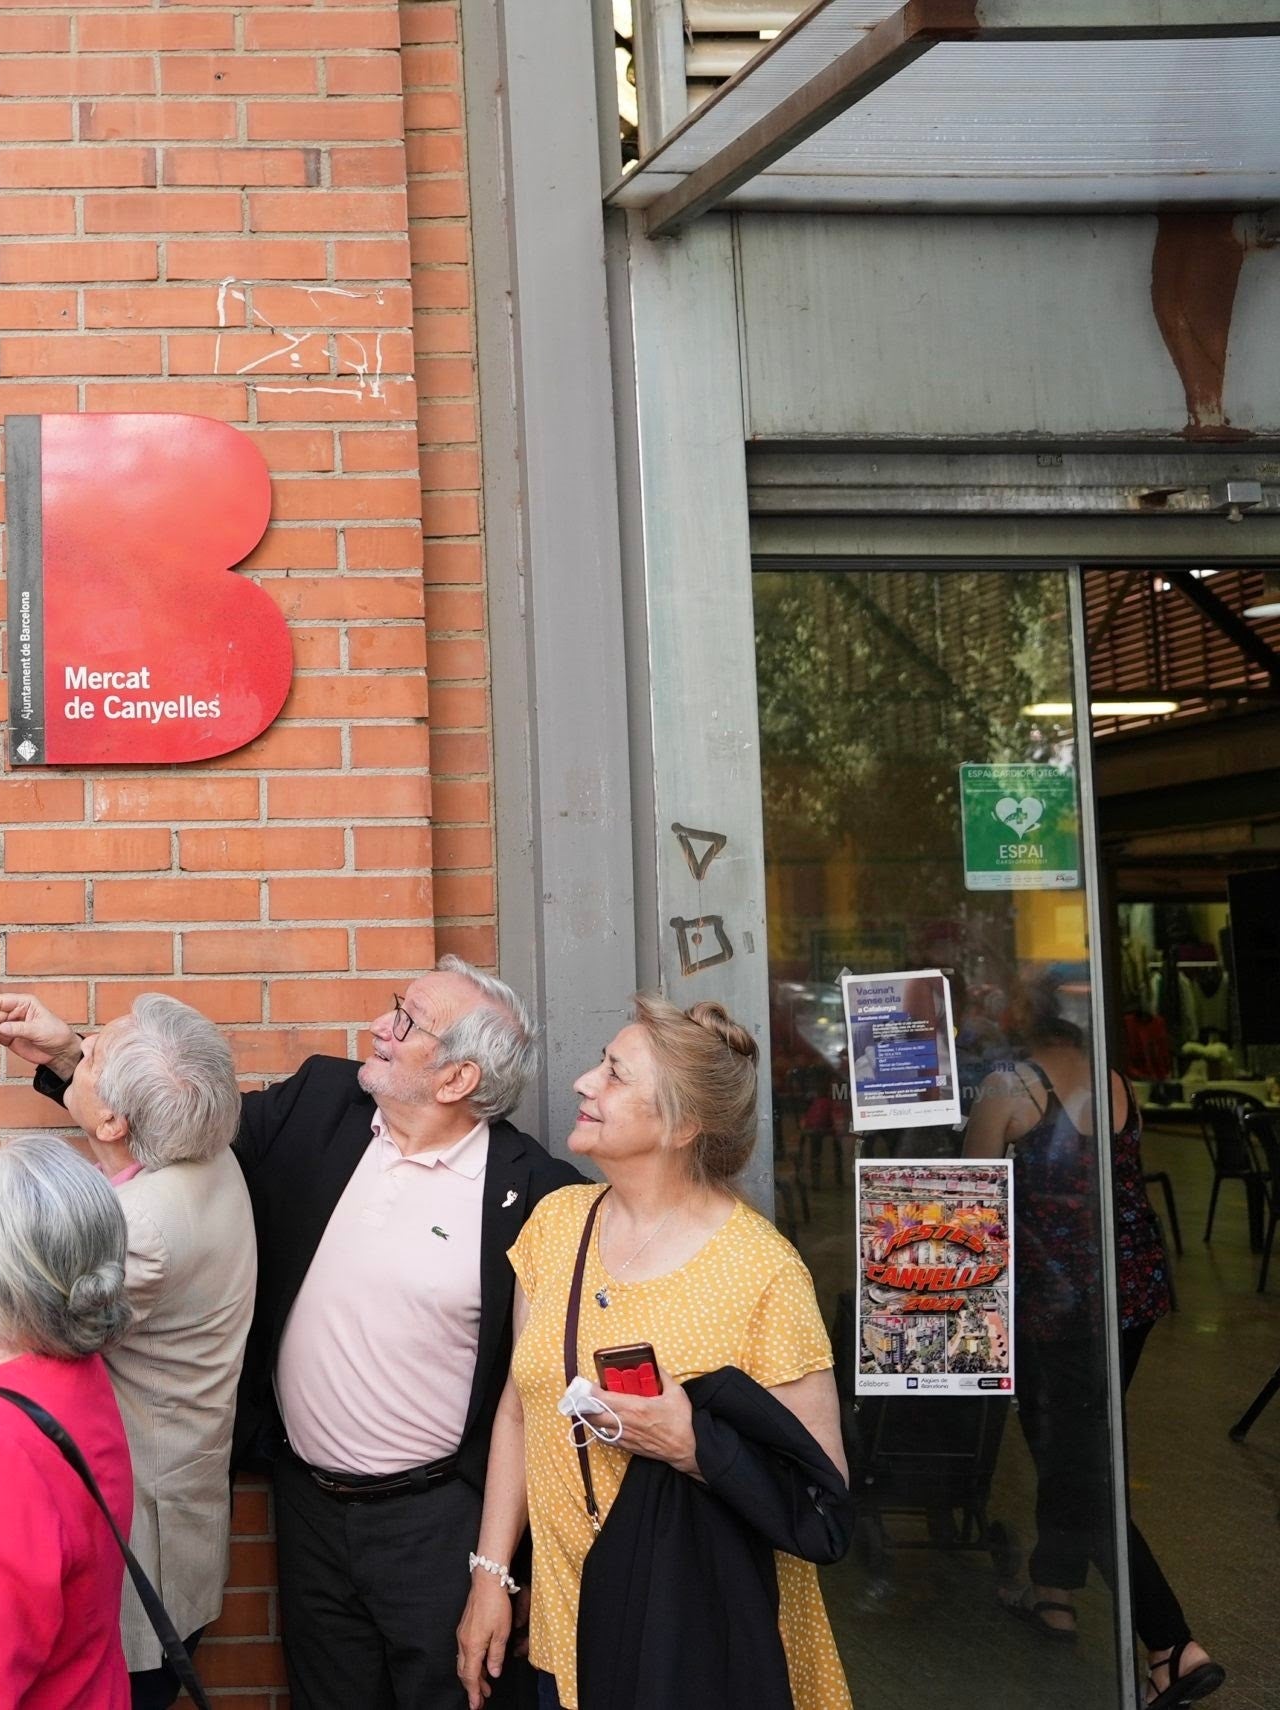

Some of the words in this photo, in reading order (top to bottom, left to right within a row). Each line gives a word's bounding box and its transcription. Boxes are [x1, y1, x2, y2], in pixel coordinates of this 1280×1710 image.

[20, 591, 30, 642] Barcelona
[21, 643, 31, 656] de
[21, 656, 33, 720] Ajuntament
[65, 667, 150, 690] Mercat
[64, 696, 94, 719] de
[104, 695, 221, 724] Canyelles
[999, 844, 1044, 859] ESPAI
[856, 986, 895, 996] Vacuna't
[857, 997, 883, 1005] sense
[885, 995, 901, 1004] cita
[863, 1005, 897, 1014] Catalunya
[881, 1223, 986, 1262] FESTES
[866, 1264, 1003, 1291] CANYELLES
[903, 1296, 965, 1312] 2021
